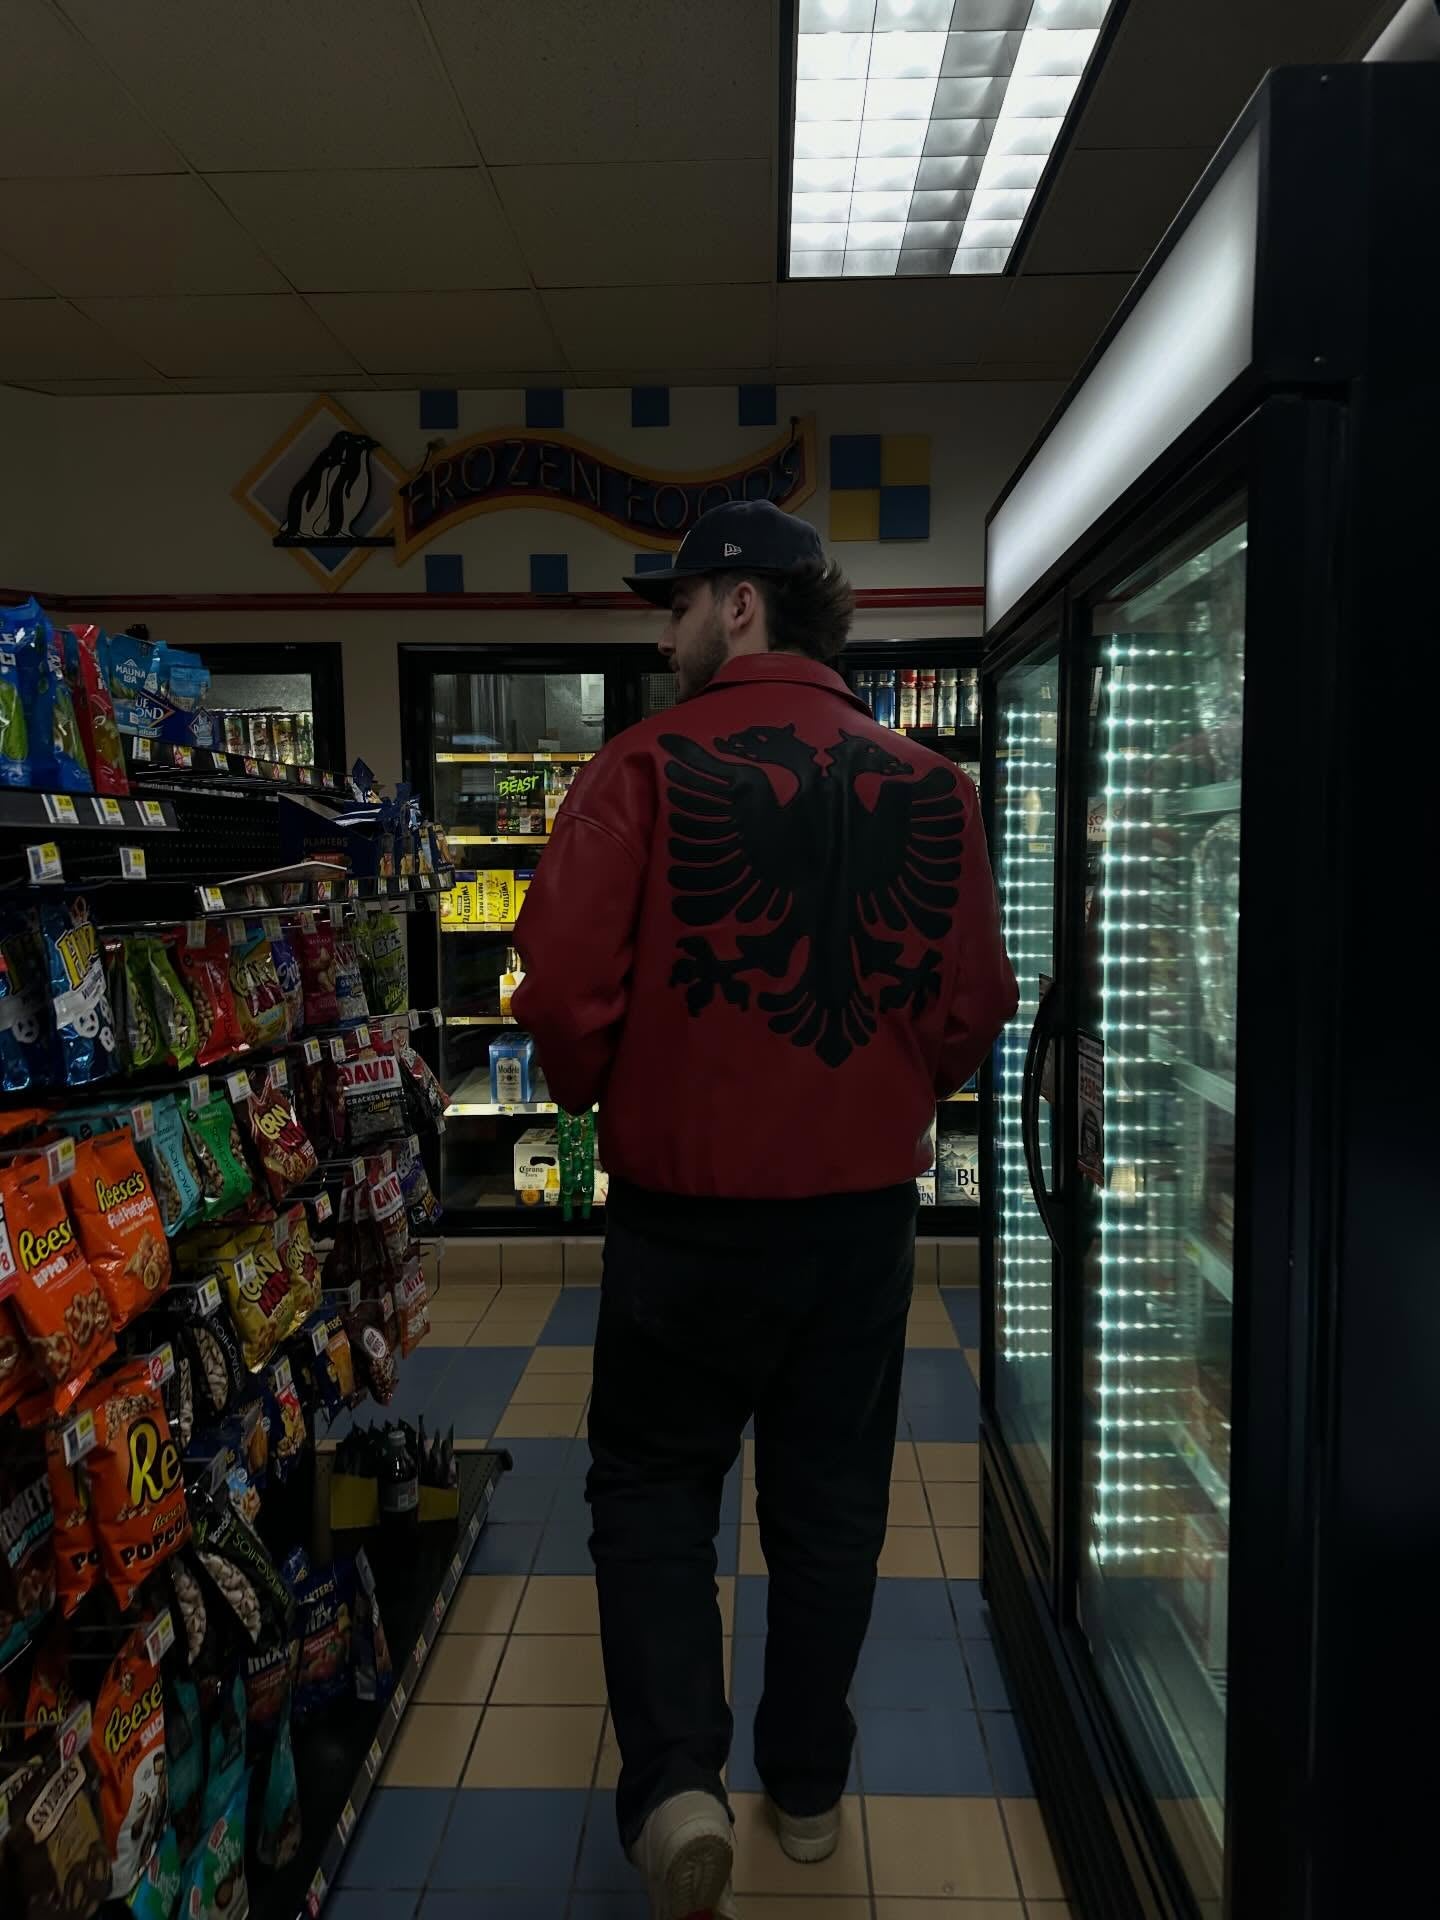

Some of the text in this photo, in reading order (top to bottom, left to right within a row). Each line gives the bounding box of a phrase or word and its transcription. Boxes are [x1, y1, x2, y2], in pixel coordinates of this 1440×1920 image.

[407, 440, 600, 526] FROZEN
[116, 664, 146, 679] MAUNA
[497, 776, 540, 797] BEAST
[303, 838, 349, 848] PLANTERS
[501, 881, 510, 907] TWISTED
[519, 1165, 544, 1174] Corona
[95, 1171, 145, 1213] Reese's
